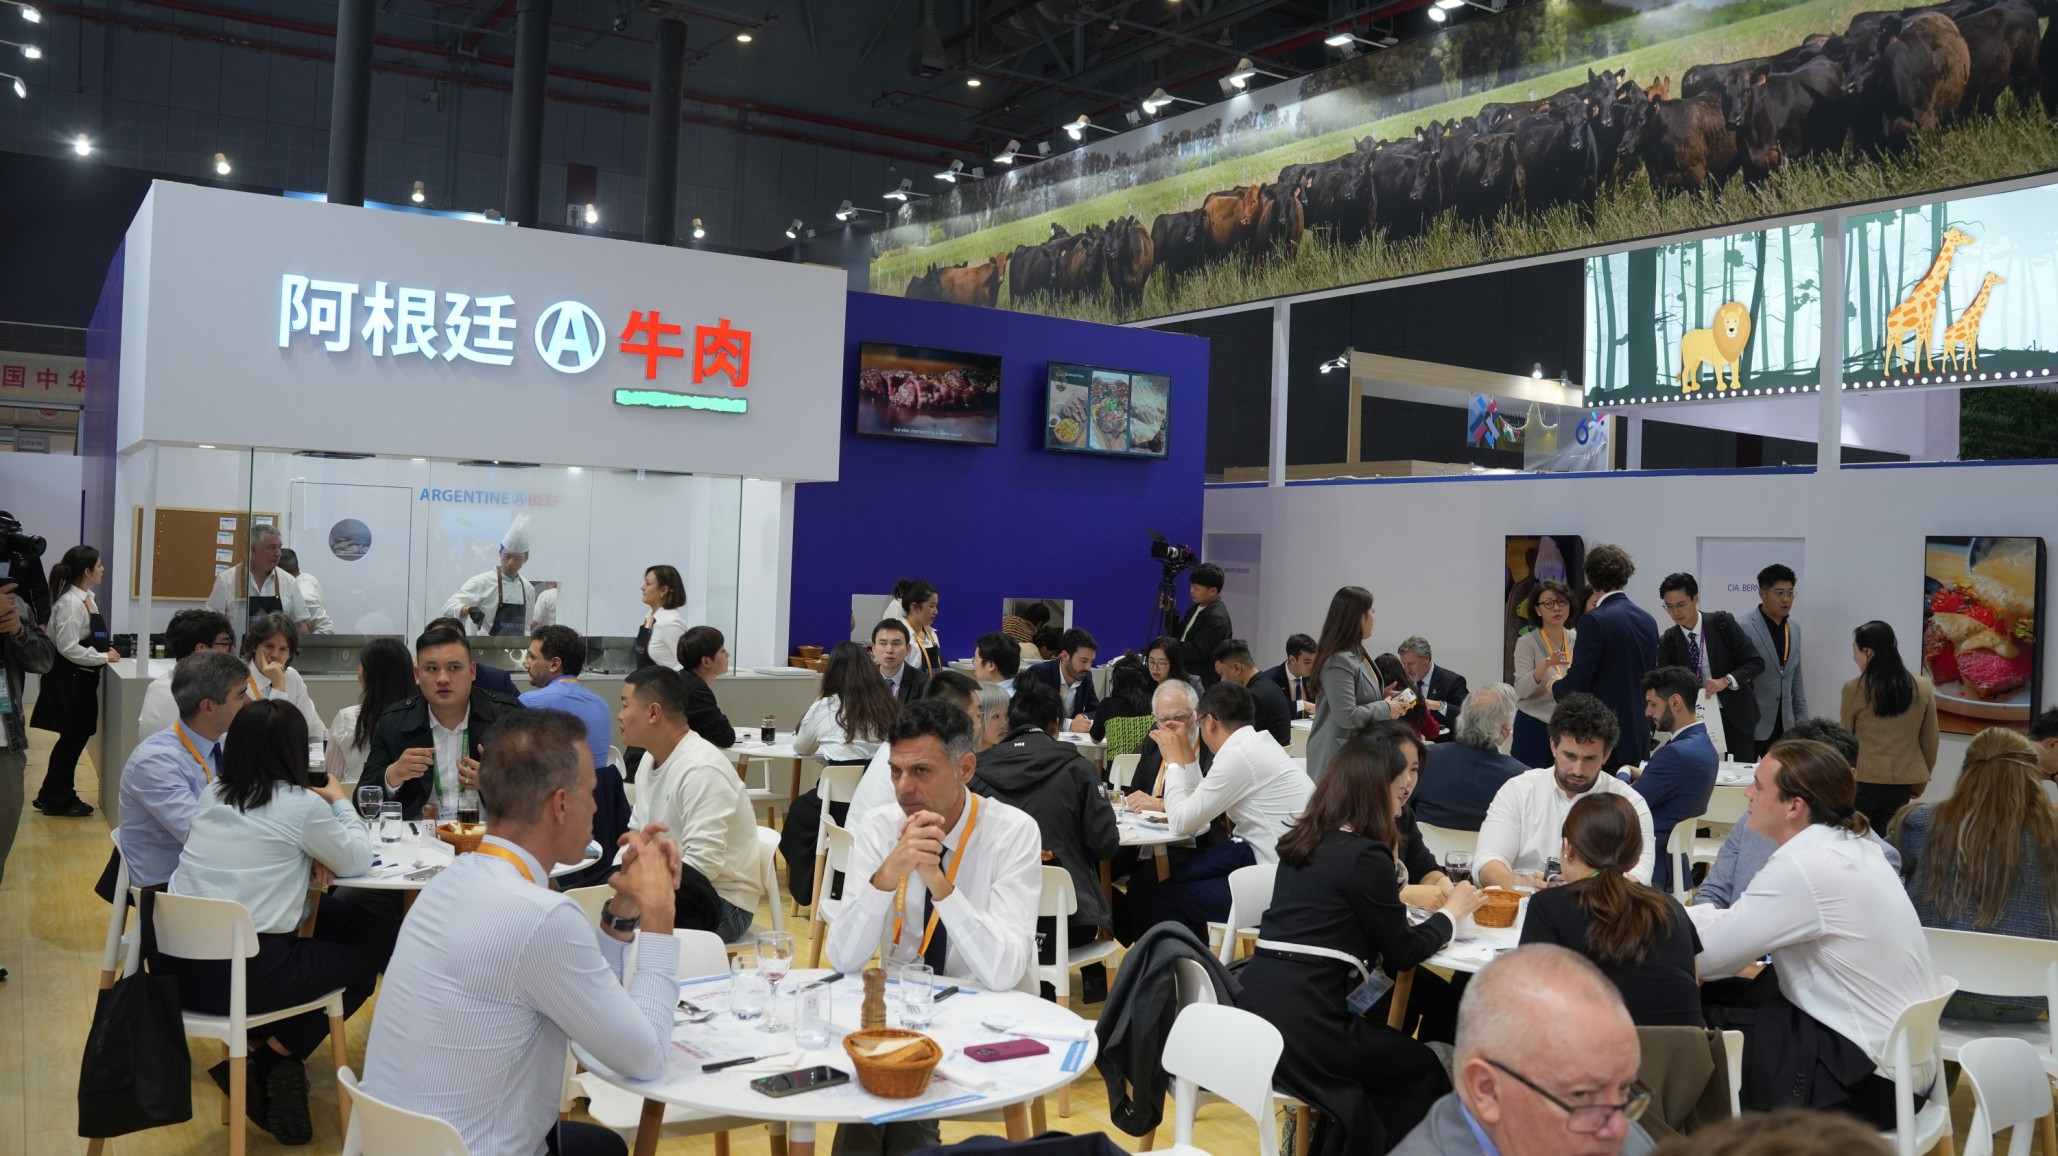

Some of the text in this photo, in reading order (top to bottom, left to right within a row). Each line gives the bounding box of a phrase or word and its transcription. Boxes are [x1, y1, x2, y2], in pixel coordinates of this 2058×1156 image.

[278, 273, 516, 366] 阿根廷
[618, 309, 752, 388] 牛肉
[420, 488, 509, 505] ARGENTINE
[528, 493, 561, 507] BEEF
[1727, 583, 1740, 592] CIA.
[425, 823, 433, 831] 12
[807, 998, 817, 1009] 13
